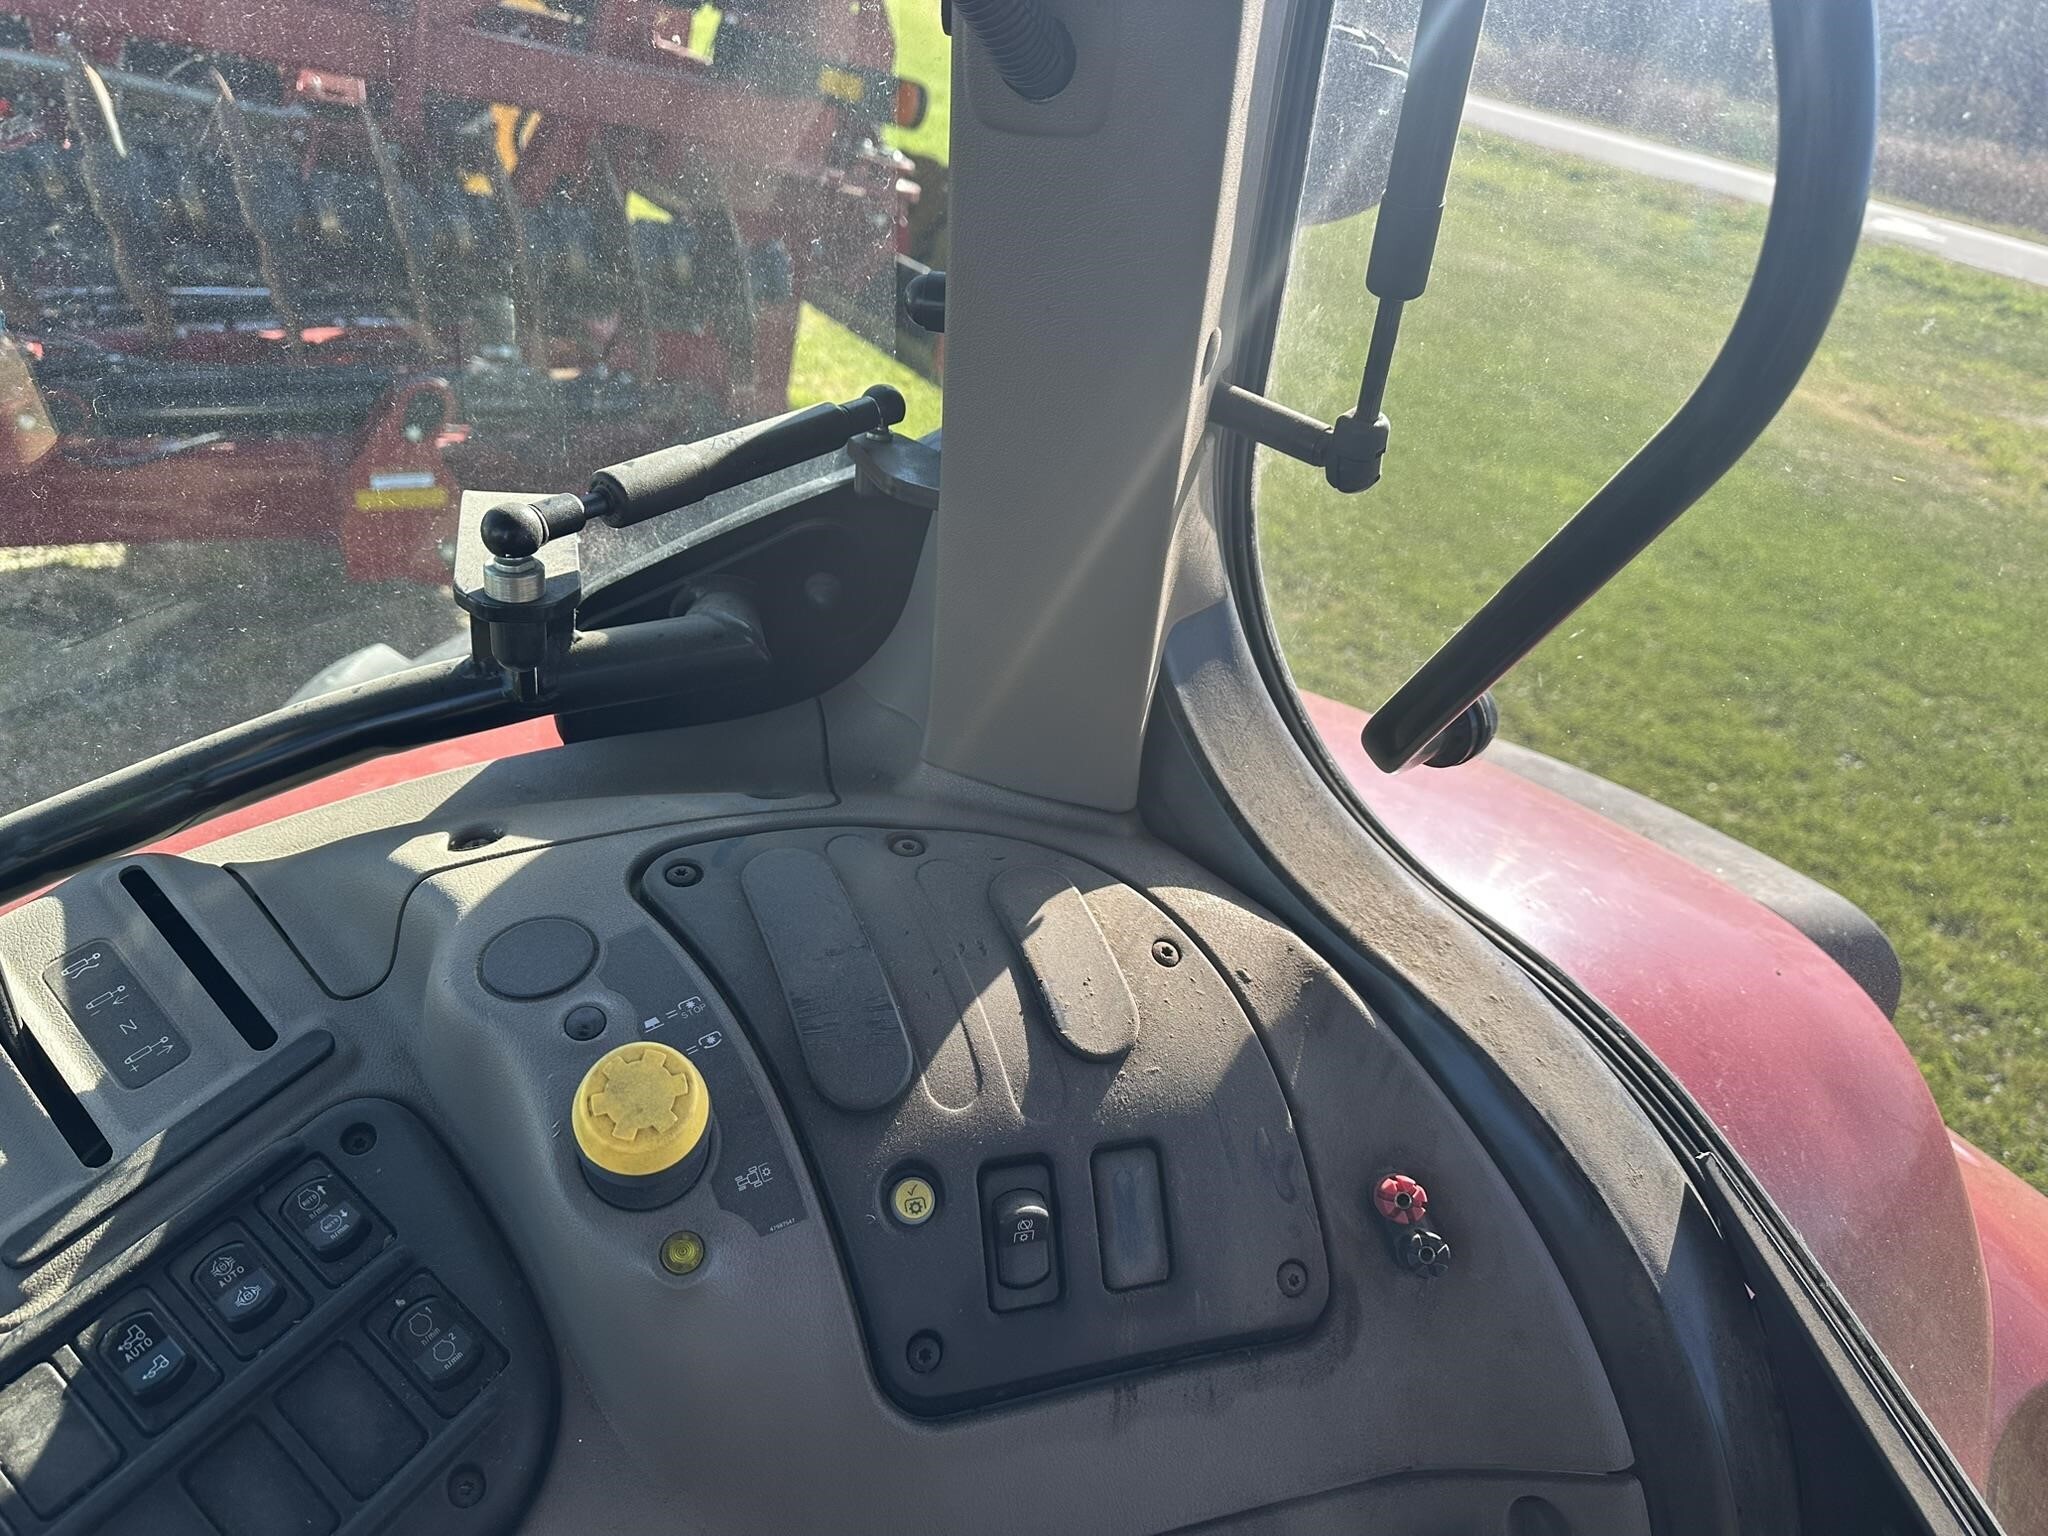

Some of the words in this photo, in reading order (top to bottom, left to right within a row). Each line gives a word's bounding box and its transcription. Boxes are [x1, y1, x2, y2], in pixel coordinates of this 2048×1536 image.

[681, 1003, 706, 1019] STOP
[119, 1018, 138, 1035] N
[218, 1265, 245, 1288] AUTO
[425, 1306, 433, 1314] 1
[420, 1327, 441, 1347] n/min
[448, 1332, 457, 1341] 2
[124, 1337, 153, 1363] AUTO
[443, 1351, 464, 1371] n/min
